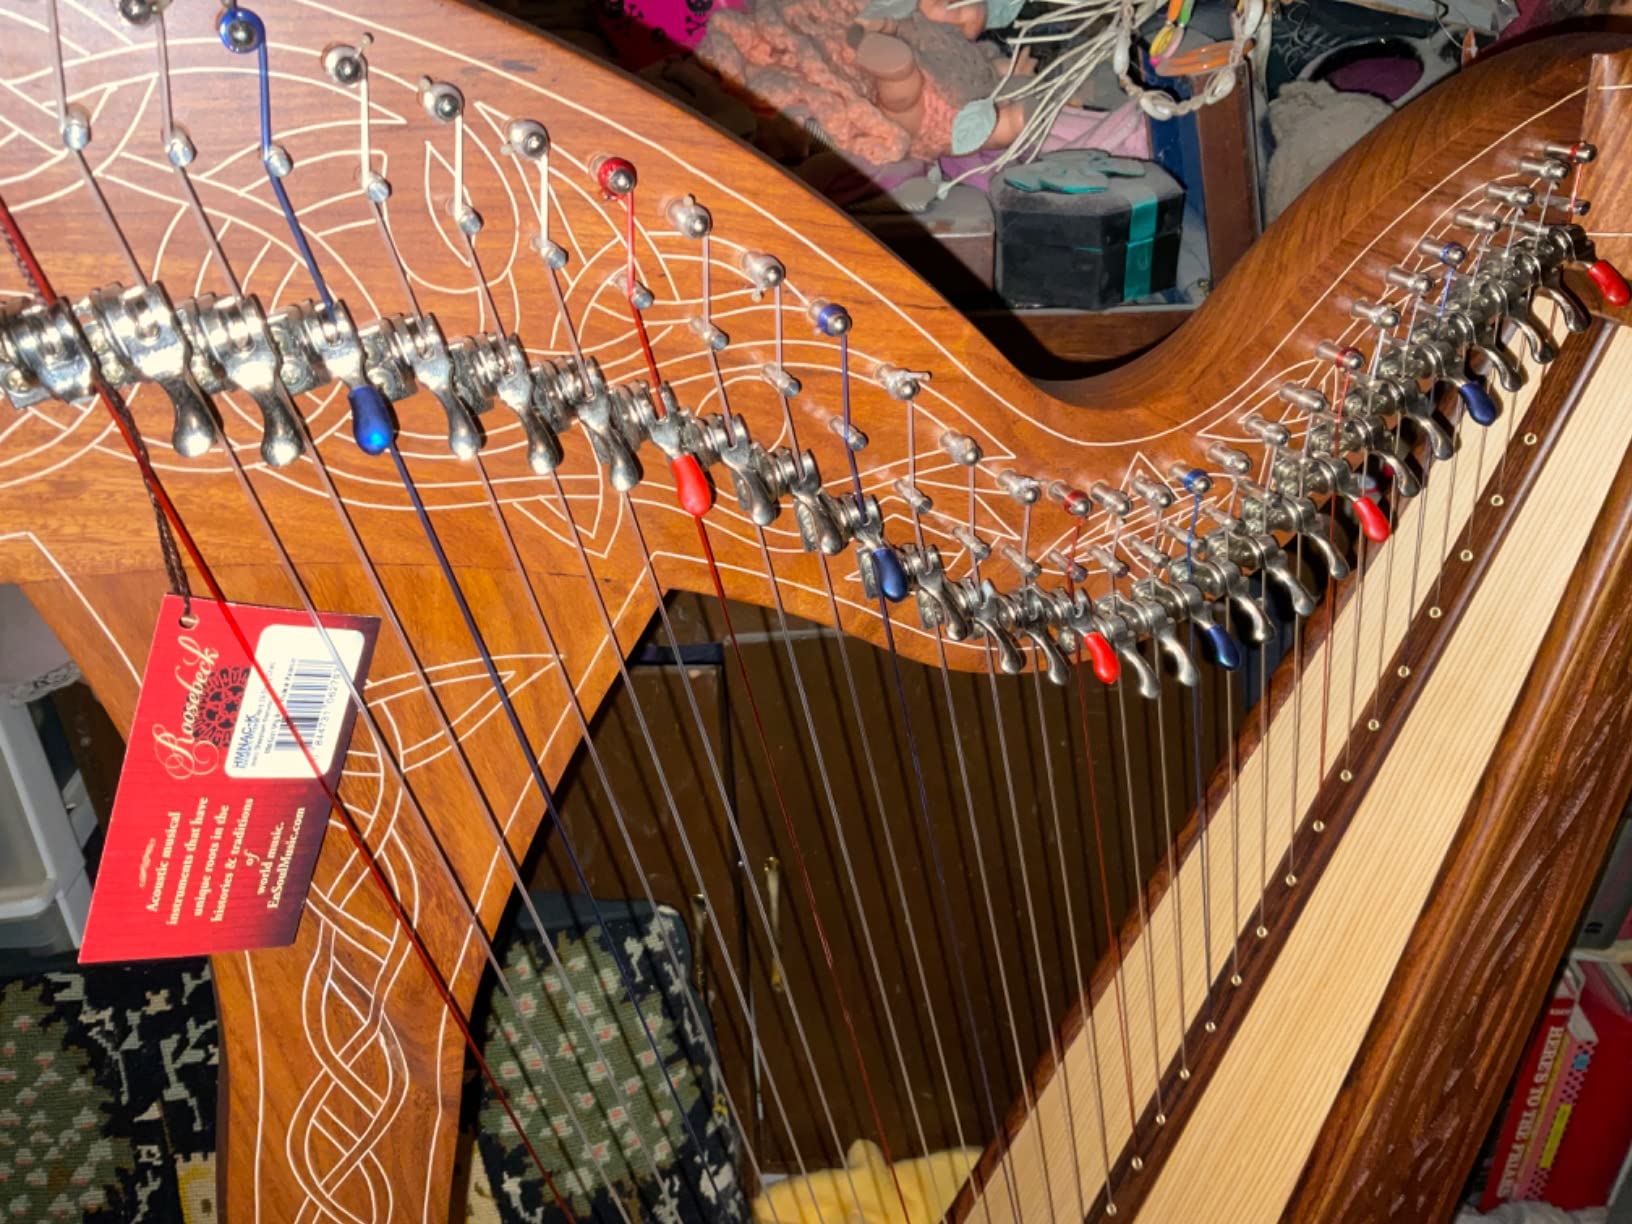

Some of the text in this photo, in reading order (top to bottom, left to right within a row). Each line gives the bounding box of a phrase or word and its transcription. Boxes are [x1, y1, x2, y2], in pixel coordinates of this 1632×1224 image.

[152, 636, 220, 780] Roosebeck
[146, 811, 181, 913] Acoustic musical
[166, 796, 208, 925] instruments that have
[194, 804, 229, 917] unique roots in the
[210, 798, 254, 922] histories & traditions
[244, 849, 260, 867] of
[257, 821, 285, 895] world music.
[267, 807, 306, 909] EnSoulMusic.com
